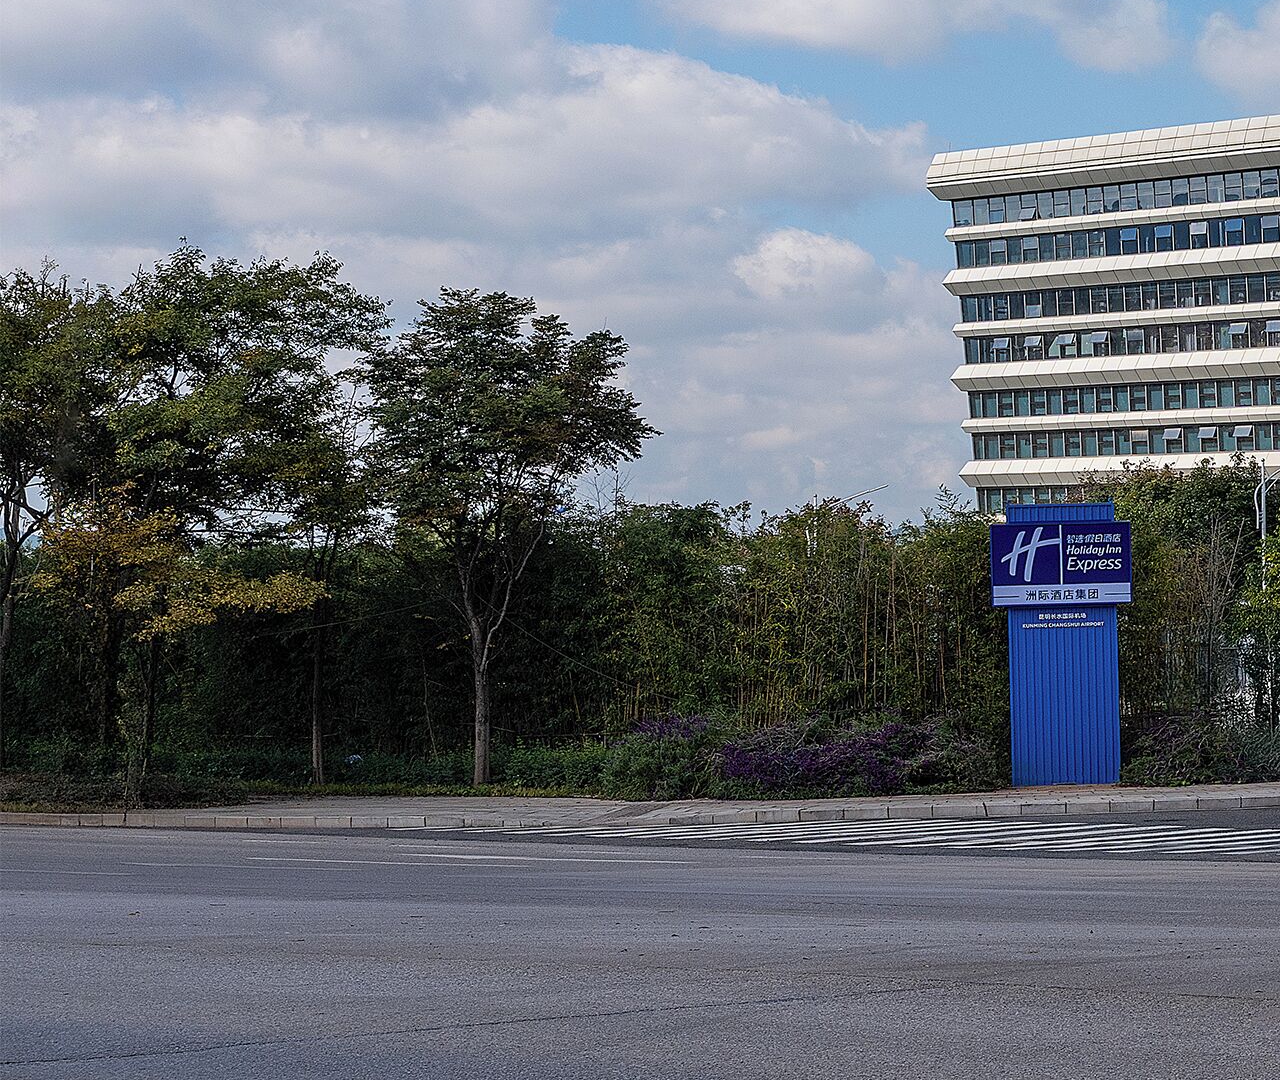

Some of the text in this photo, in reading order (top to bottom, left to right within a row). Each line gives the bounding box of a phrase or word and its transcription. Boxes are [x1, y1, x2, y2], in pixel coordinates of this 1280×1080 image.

[1066, 544, 1122, 556] Holiday Inn
[1067, 556, 1122, 573] Express
[1025, 589, 1098, 601] 洲际酒店集团
